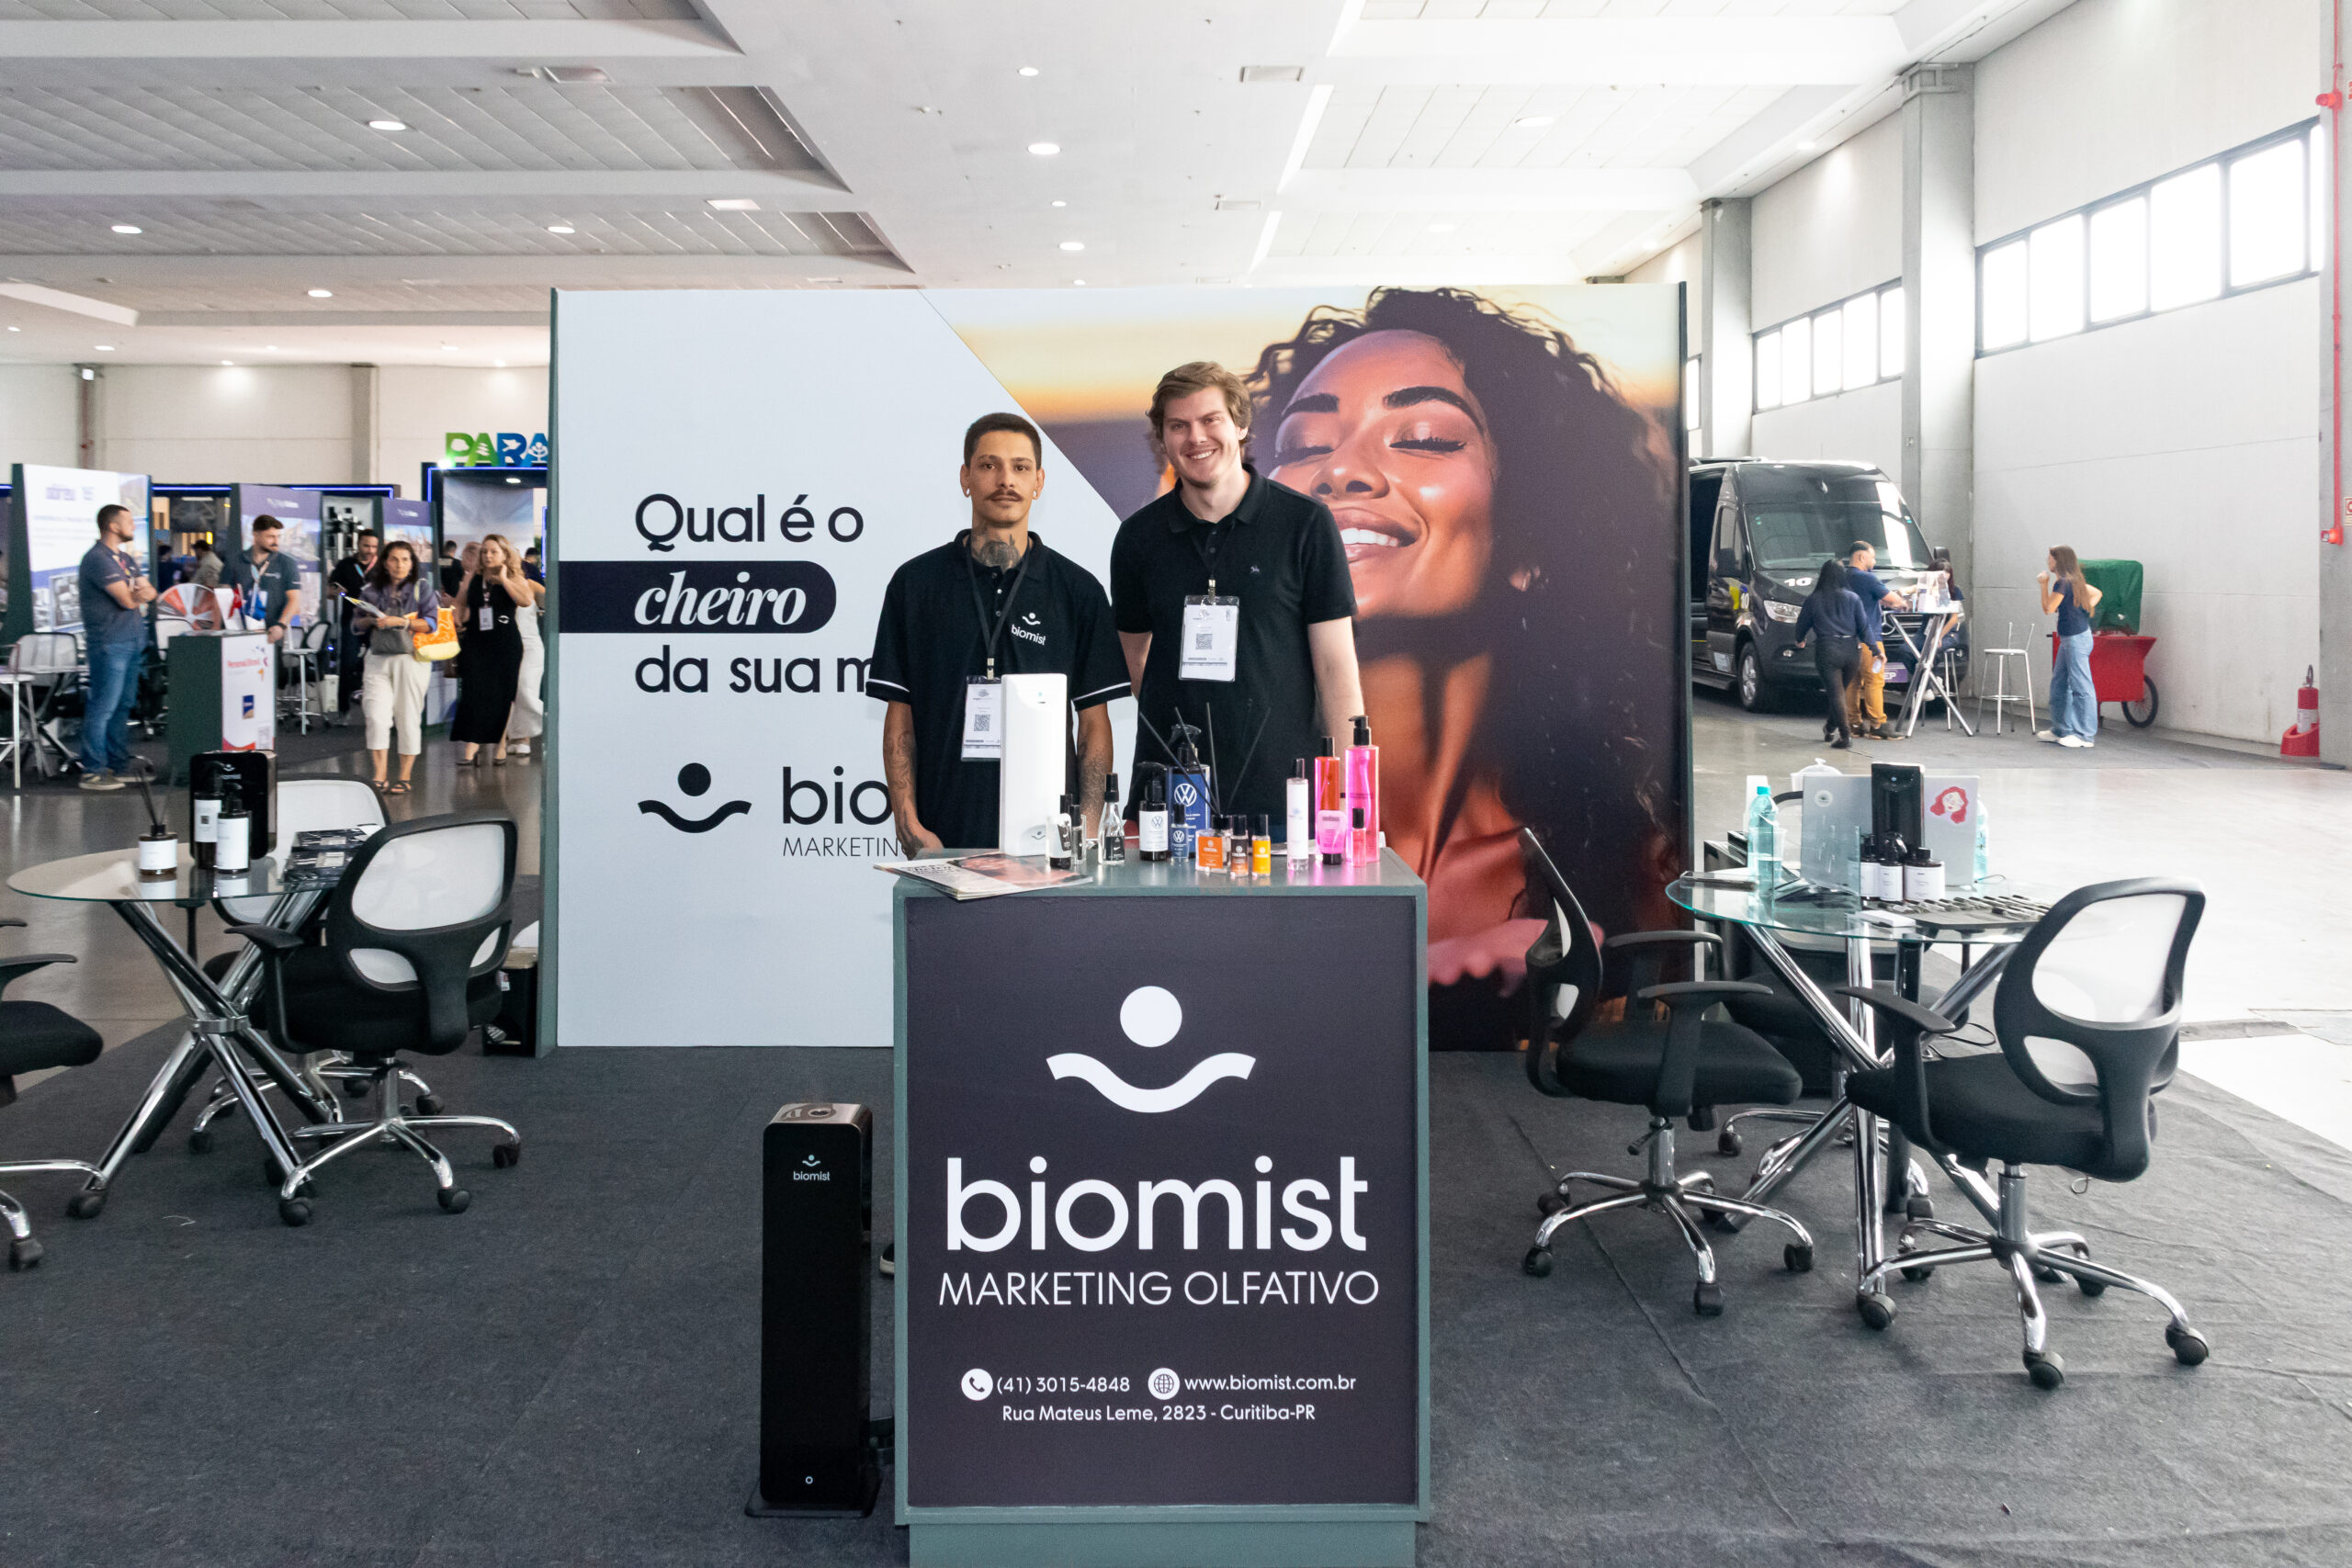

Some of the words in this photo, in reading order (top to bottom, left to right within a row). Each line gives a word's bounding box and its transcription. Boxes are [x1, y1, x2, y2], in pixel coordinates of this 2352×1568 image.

[635, 493, 765, 552] Qual
[780, 493, 815, 543] é
[828, 505, 864, 543] o
[634, 570, 807, 626] cheiro
[1012, 624, 1046, 646] biomist
[635, 644, 709, 694] da
[729, 657, 820, 694] sua
[782, 837, 907, 857] MARKETIN
[793, 1170, 831, 1181] biomist
[946, 1155, 1369, 1253] biomist
[939, 1270, 1172, 1306] MARKETING
[1184, 1270, 1379, 1305] OLFATIVO
[997, 1376, 1032, 1395] (41)
[1035, 1376, 1131, 1393] 3015-4848
[1184, 1374, 1357, 1391] www.biomist.com.br
[1002, 1405, 1035, 1421] Rua
[1039, 1405, 1102, 1421] Mateus
[1106, 1405, 1159, 1423] Leme,
[1162, 1404, 1206, 1421] 2823
[1220, 1404, 1316, 1421] Curitiba-PR
